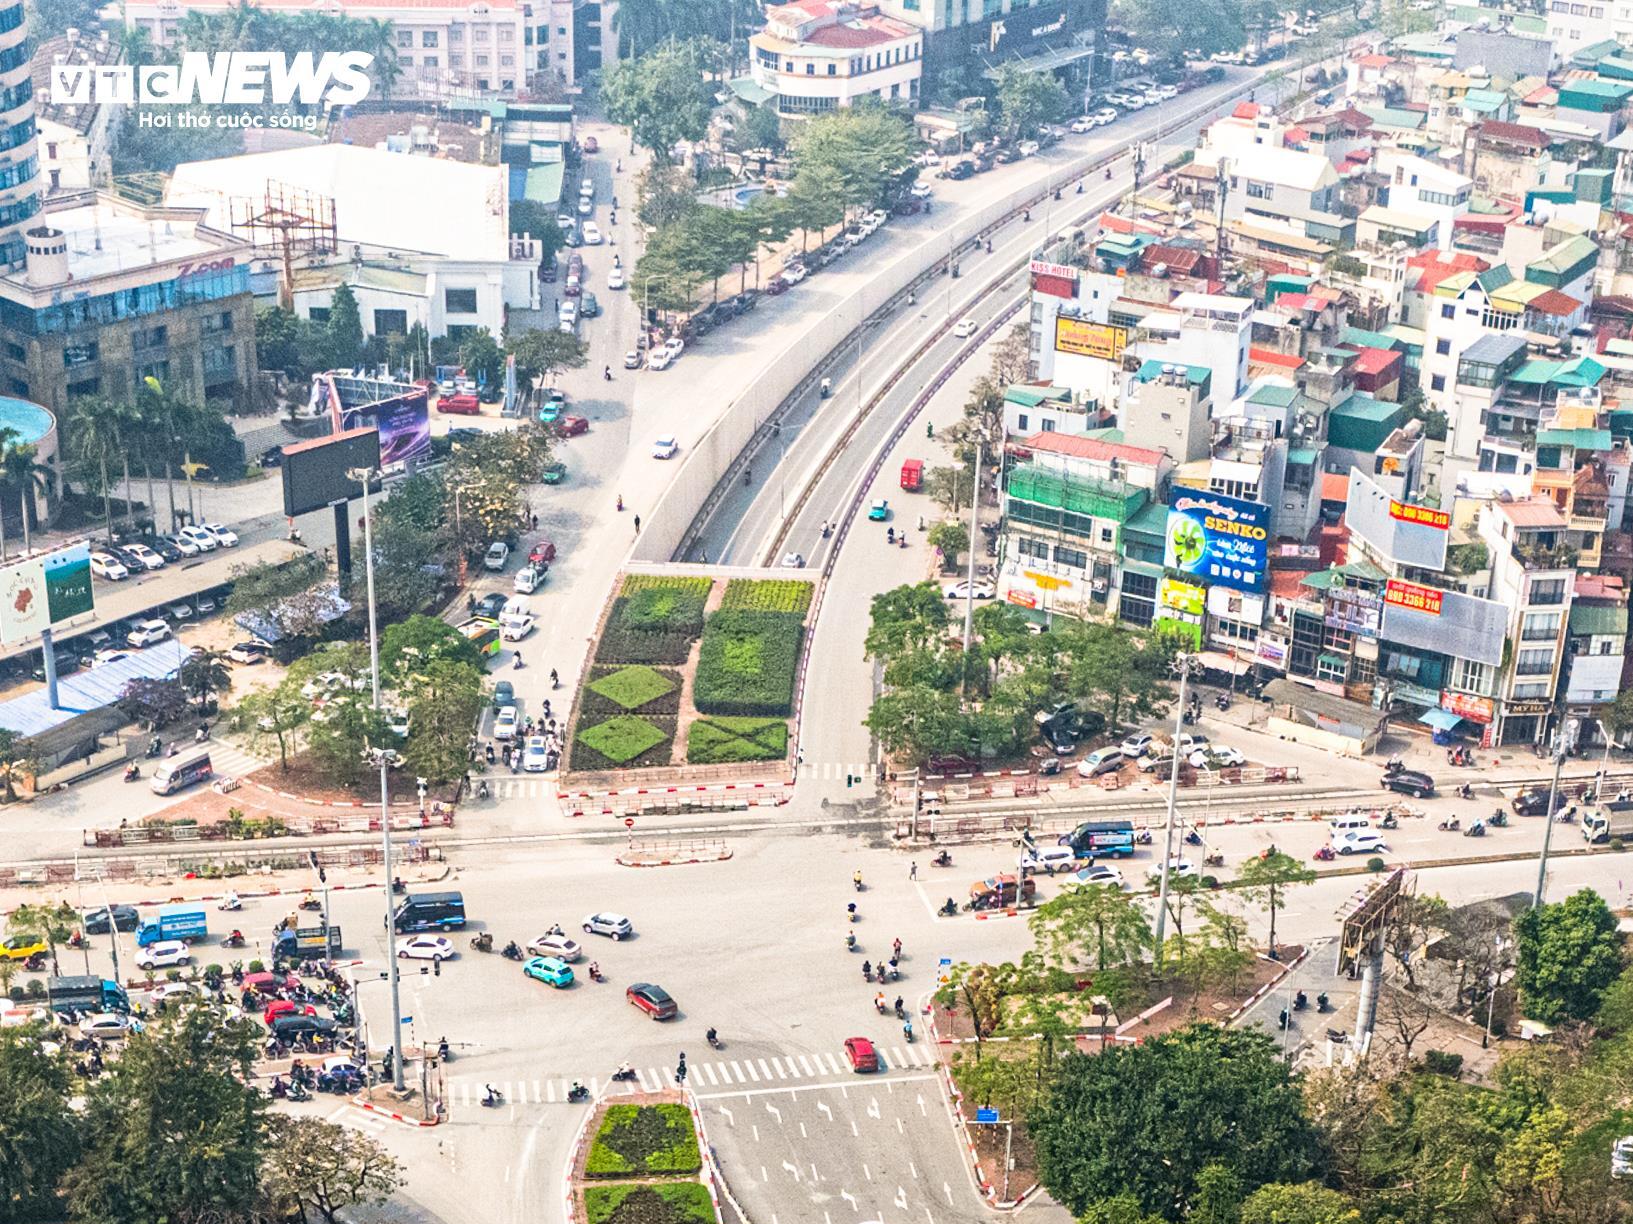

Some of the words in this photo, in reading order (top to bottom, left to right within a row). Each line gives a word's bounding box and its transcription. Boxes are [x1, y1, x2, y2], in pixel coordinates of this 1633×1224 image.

[1030, 262, 1050, 274] KISS
[1051, 265, 1075, 278] HOTEL
[1204, 515, 1267, 540] SENKO
[1404, 593, 1425, 608] 3366
